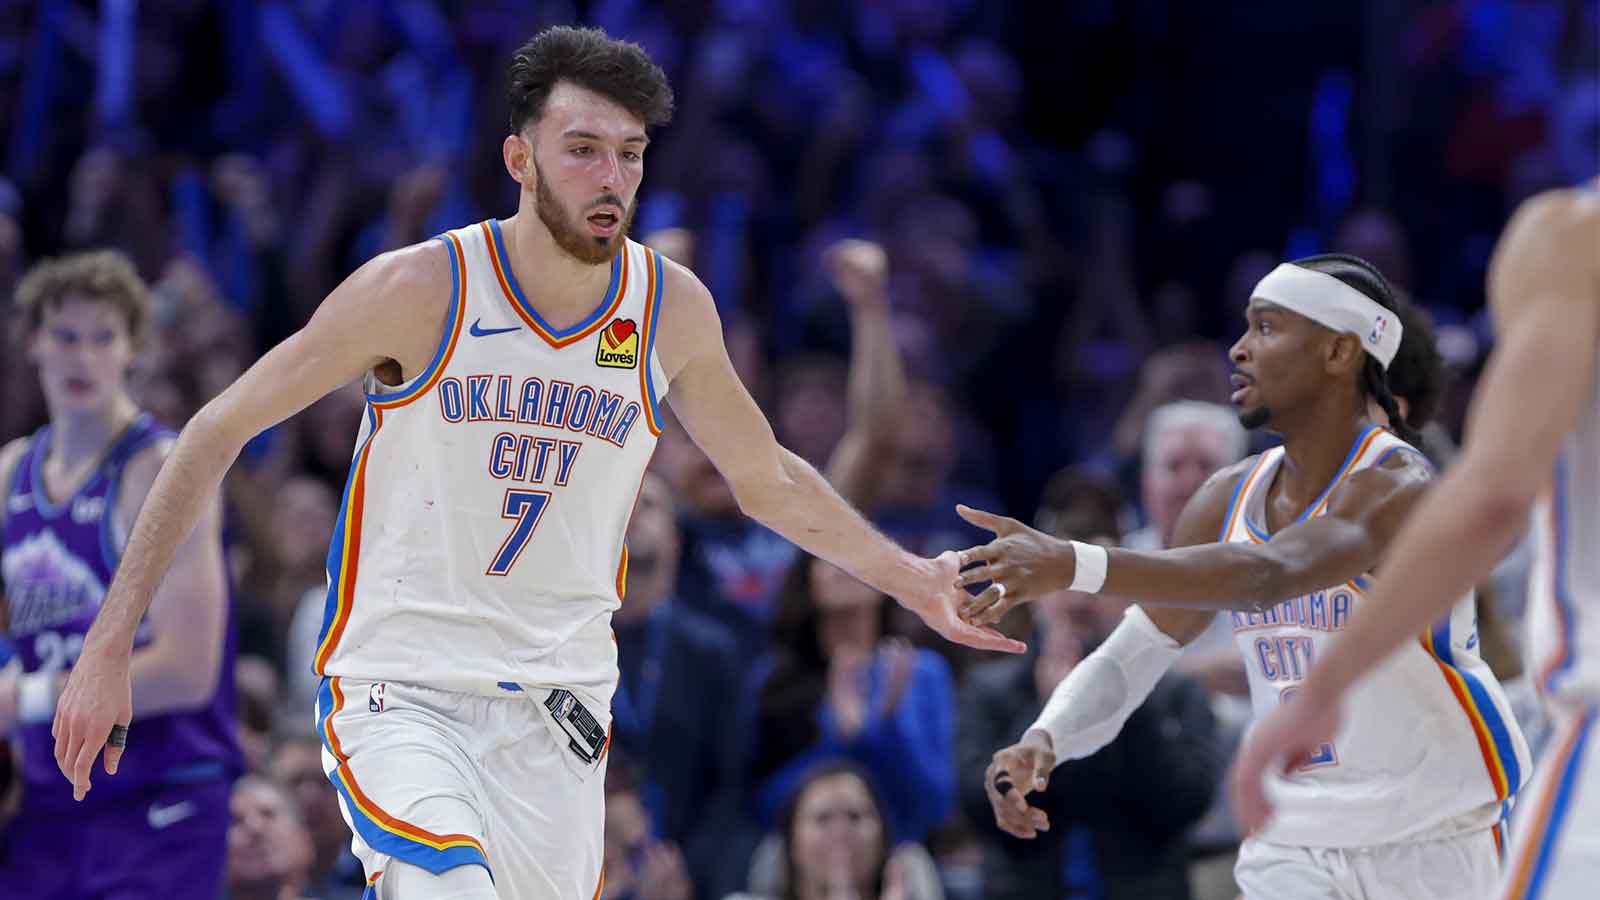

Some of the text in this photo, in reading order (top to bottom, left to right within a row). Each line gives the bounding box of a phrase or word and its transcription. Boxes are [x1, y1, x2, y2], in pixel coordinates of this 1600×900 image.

[599, 349, 634, 364] Love's
[438, 375, 641, 447] OKLAHOMA
[489, 432, 582, 486] CITY
[485, 488, 552, 576] 7
